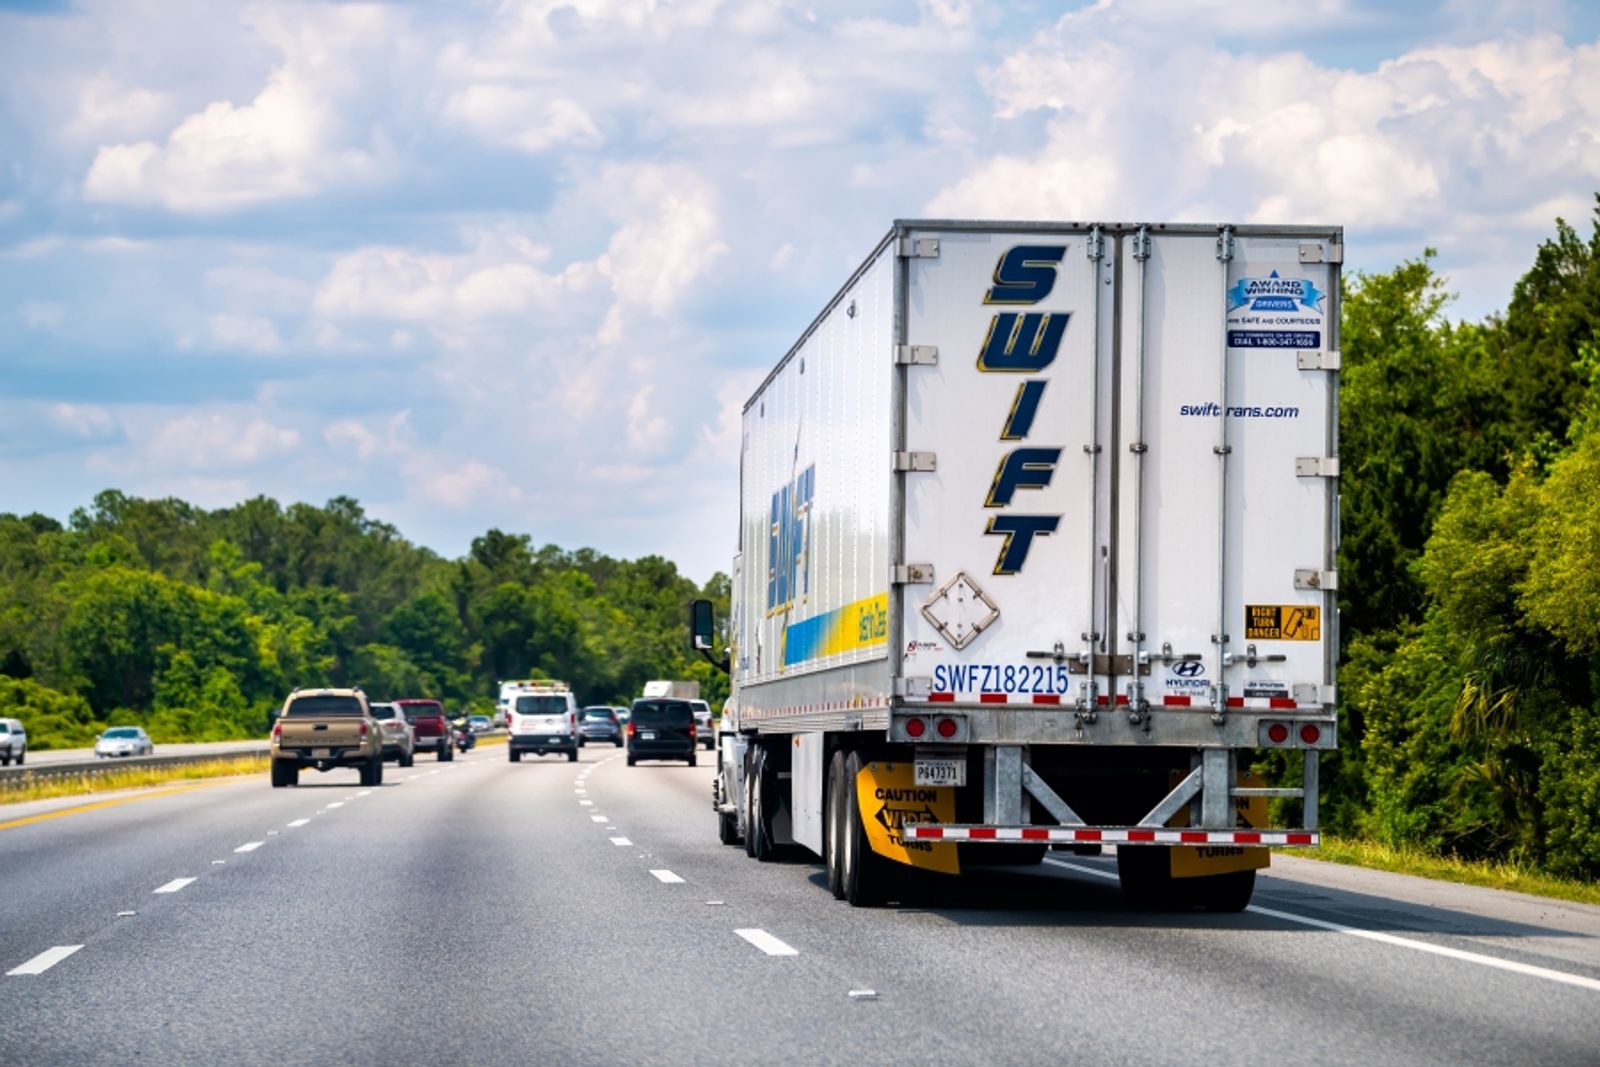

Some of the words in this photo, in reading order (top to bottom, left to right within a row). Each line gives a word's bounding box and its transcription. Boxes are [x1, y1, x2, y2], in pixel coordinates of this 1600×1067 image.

[1250, 280, 1301, 288] AWARD
[1244, 287, 1304, 295] WINNING
[1255, 299, 1293, 308] DRIVERS
[1242, 317, 1260, 325] SAFE
[1234, 338, 1252, 346] DIAL
[975, 244, 1074, 577] SWIFT
[1180, 401, 1300, 418] swiftrans.com
[1253, 617, 1275, 627] TURN
[1248, 627, 1280, 638] DANGER
[934, 664, 1069, 694] SWFZ182215
[1166, 679, 1211, 688] HYUNDAI
[875, 788, 937, 803] CAUTION
